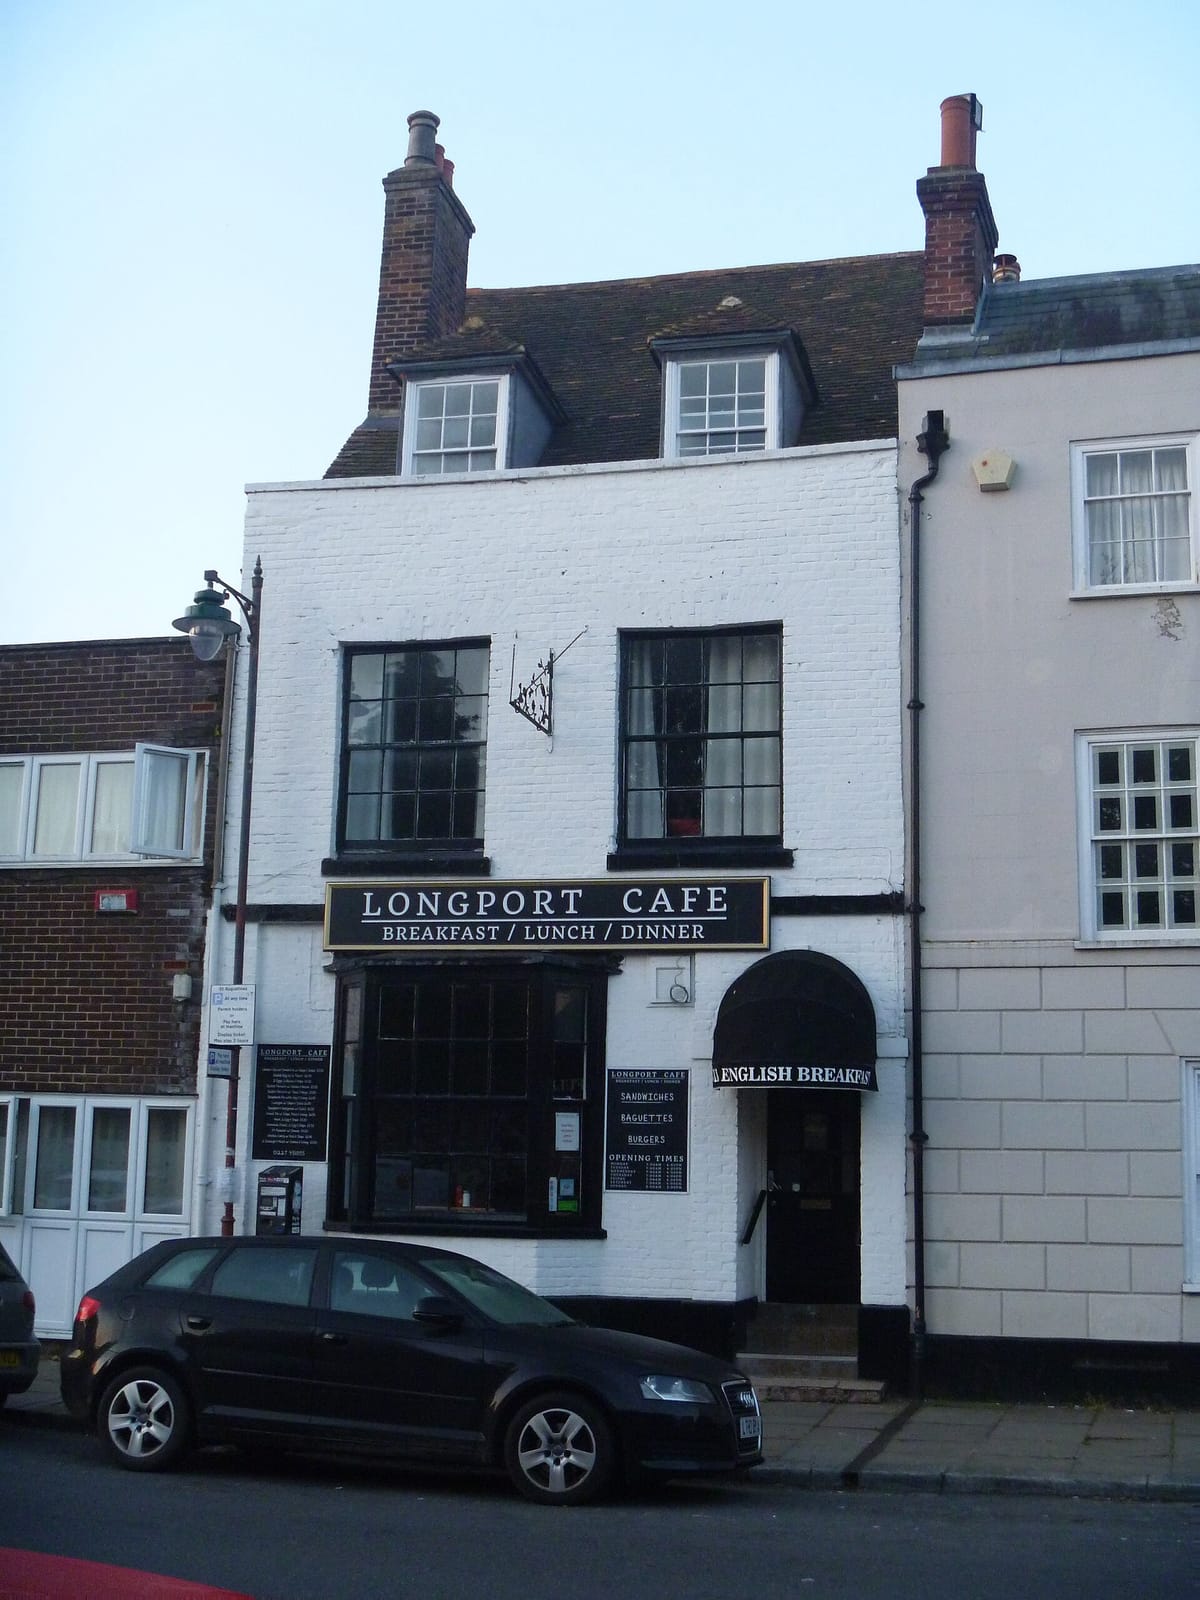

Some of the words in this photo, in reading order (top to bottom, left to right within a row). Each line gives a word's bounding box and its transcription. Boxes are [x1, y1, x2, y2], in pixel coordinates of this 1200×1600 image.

[362, 889, 583, 916] LONGPORT
[622, 887, 727, 914] CAFE
[382, 925, 500, 941] BREAKFAST
[507, 924, 516, 941] /
[524, 925, 596, 940] LUNCH
[604, 923, 613, 941] /
[621, 924, 705, 940] DINNER
[260, 1048, 303, 1057] LONGPORT
[307, 1049, 328, 1057] CAFE
[663, 1071, 686, 1079] CAFE
[721, 1066, 793, 1082] ENGLISH
[620, 1092, 674, 1101] SANDWICHES
[620, 1113, 673, 1122] BAGUETTES
[627, 1135, 666, 1144] BURGERS
[608, 1154, 651, 1162] OPENING
[655, 1155, 684, 1163] TIMES
